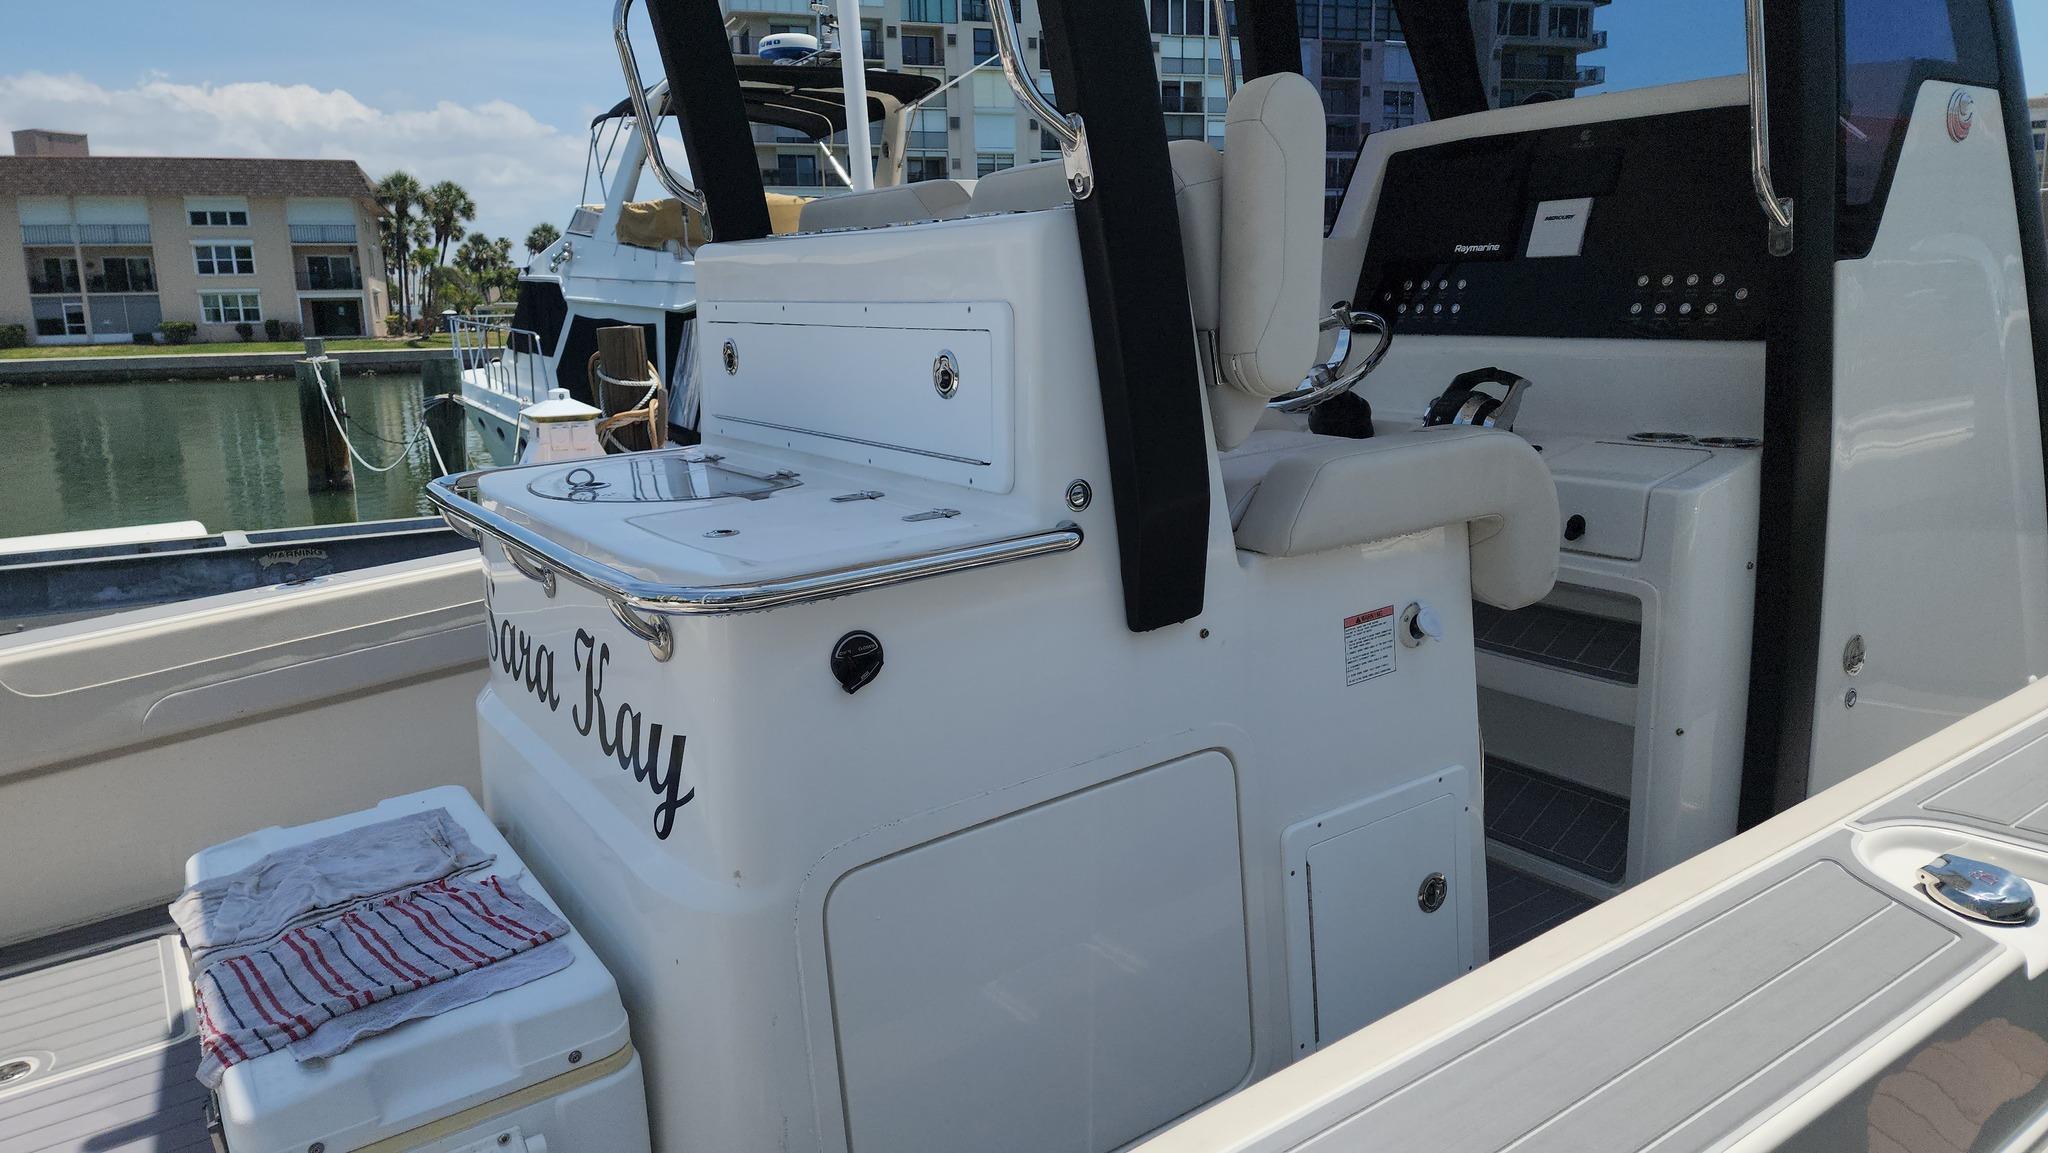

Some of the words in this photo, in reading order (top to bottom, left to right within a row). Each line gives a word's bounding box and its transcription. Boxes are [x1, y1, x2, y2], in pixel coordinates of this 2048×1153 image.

[1454, 243, 1501, 254] Raymarine
[485, 573, 560, 712] Sara
[572, 628, 695, 840] Kay
